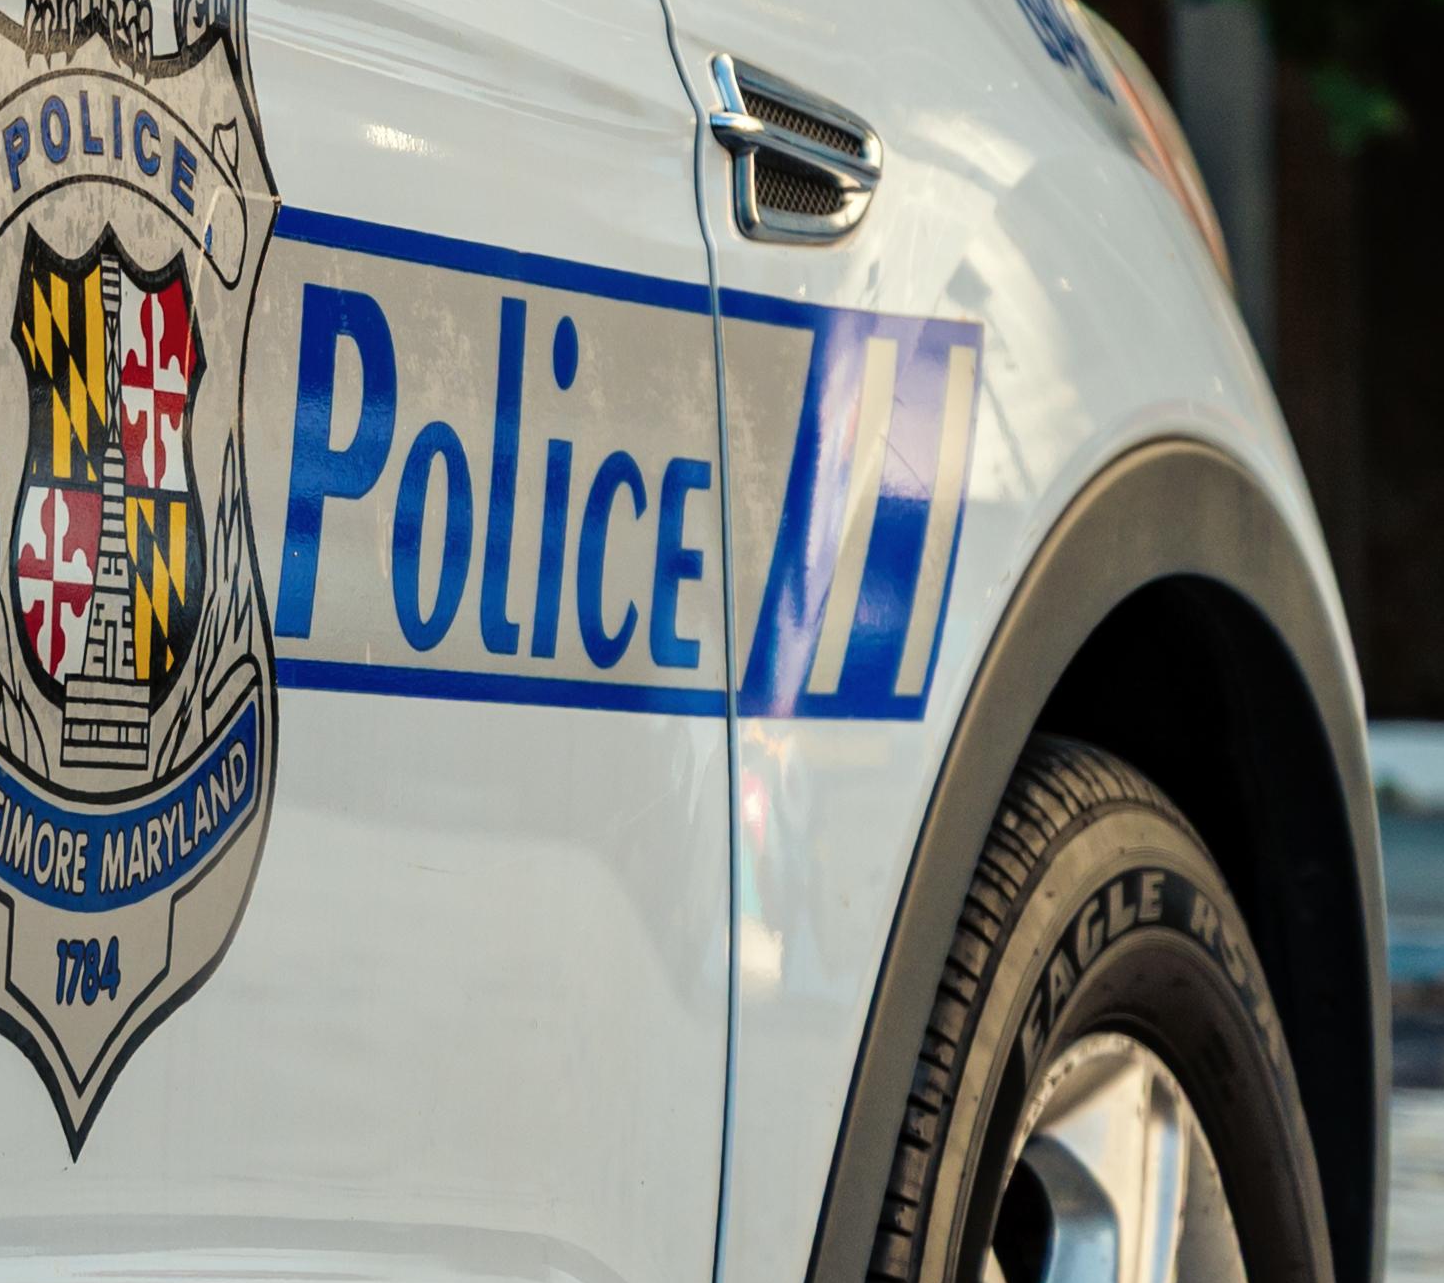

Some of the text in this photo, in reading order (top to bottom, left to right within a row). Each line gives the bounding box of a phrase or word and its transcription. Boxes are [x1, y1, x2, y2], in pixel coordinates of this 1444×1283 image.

[3, 90, 197, 216] POLICE
[99, 739, 250, 894] MARYLAND
[55, 935, 122, 1007] 1784
[1021, 870, 1166, 1073] EAGLE
